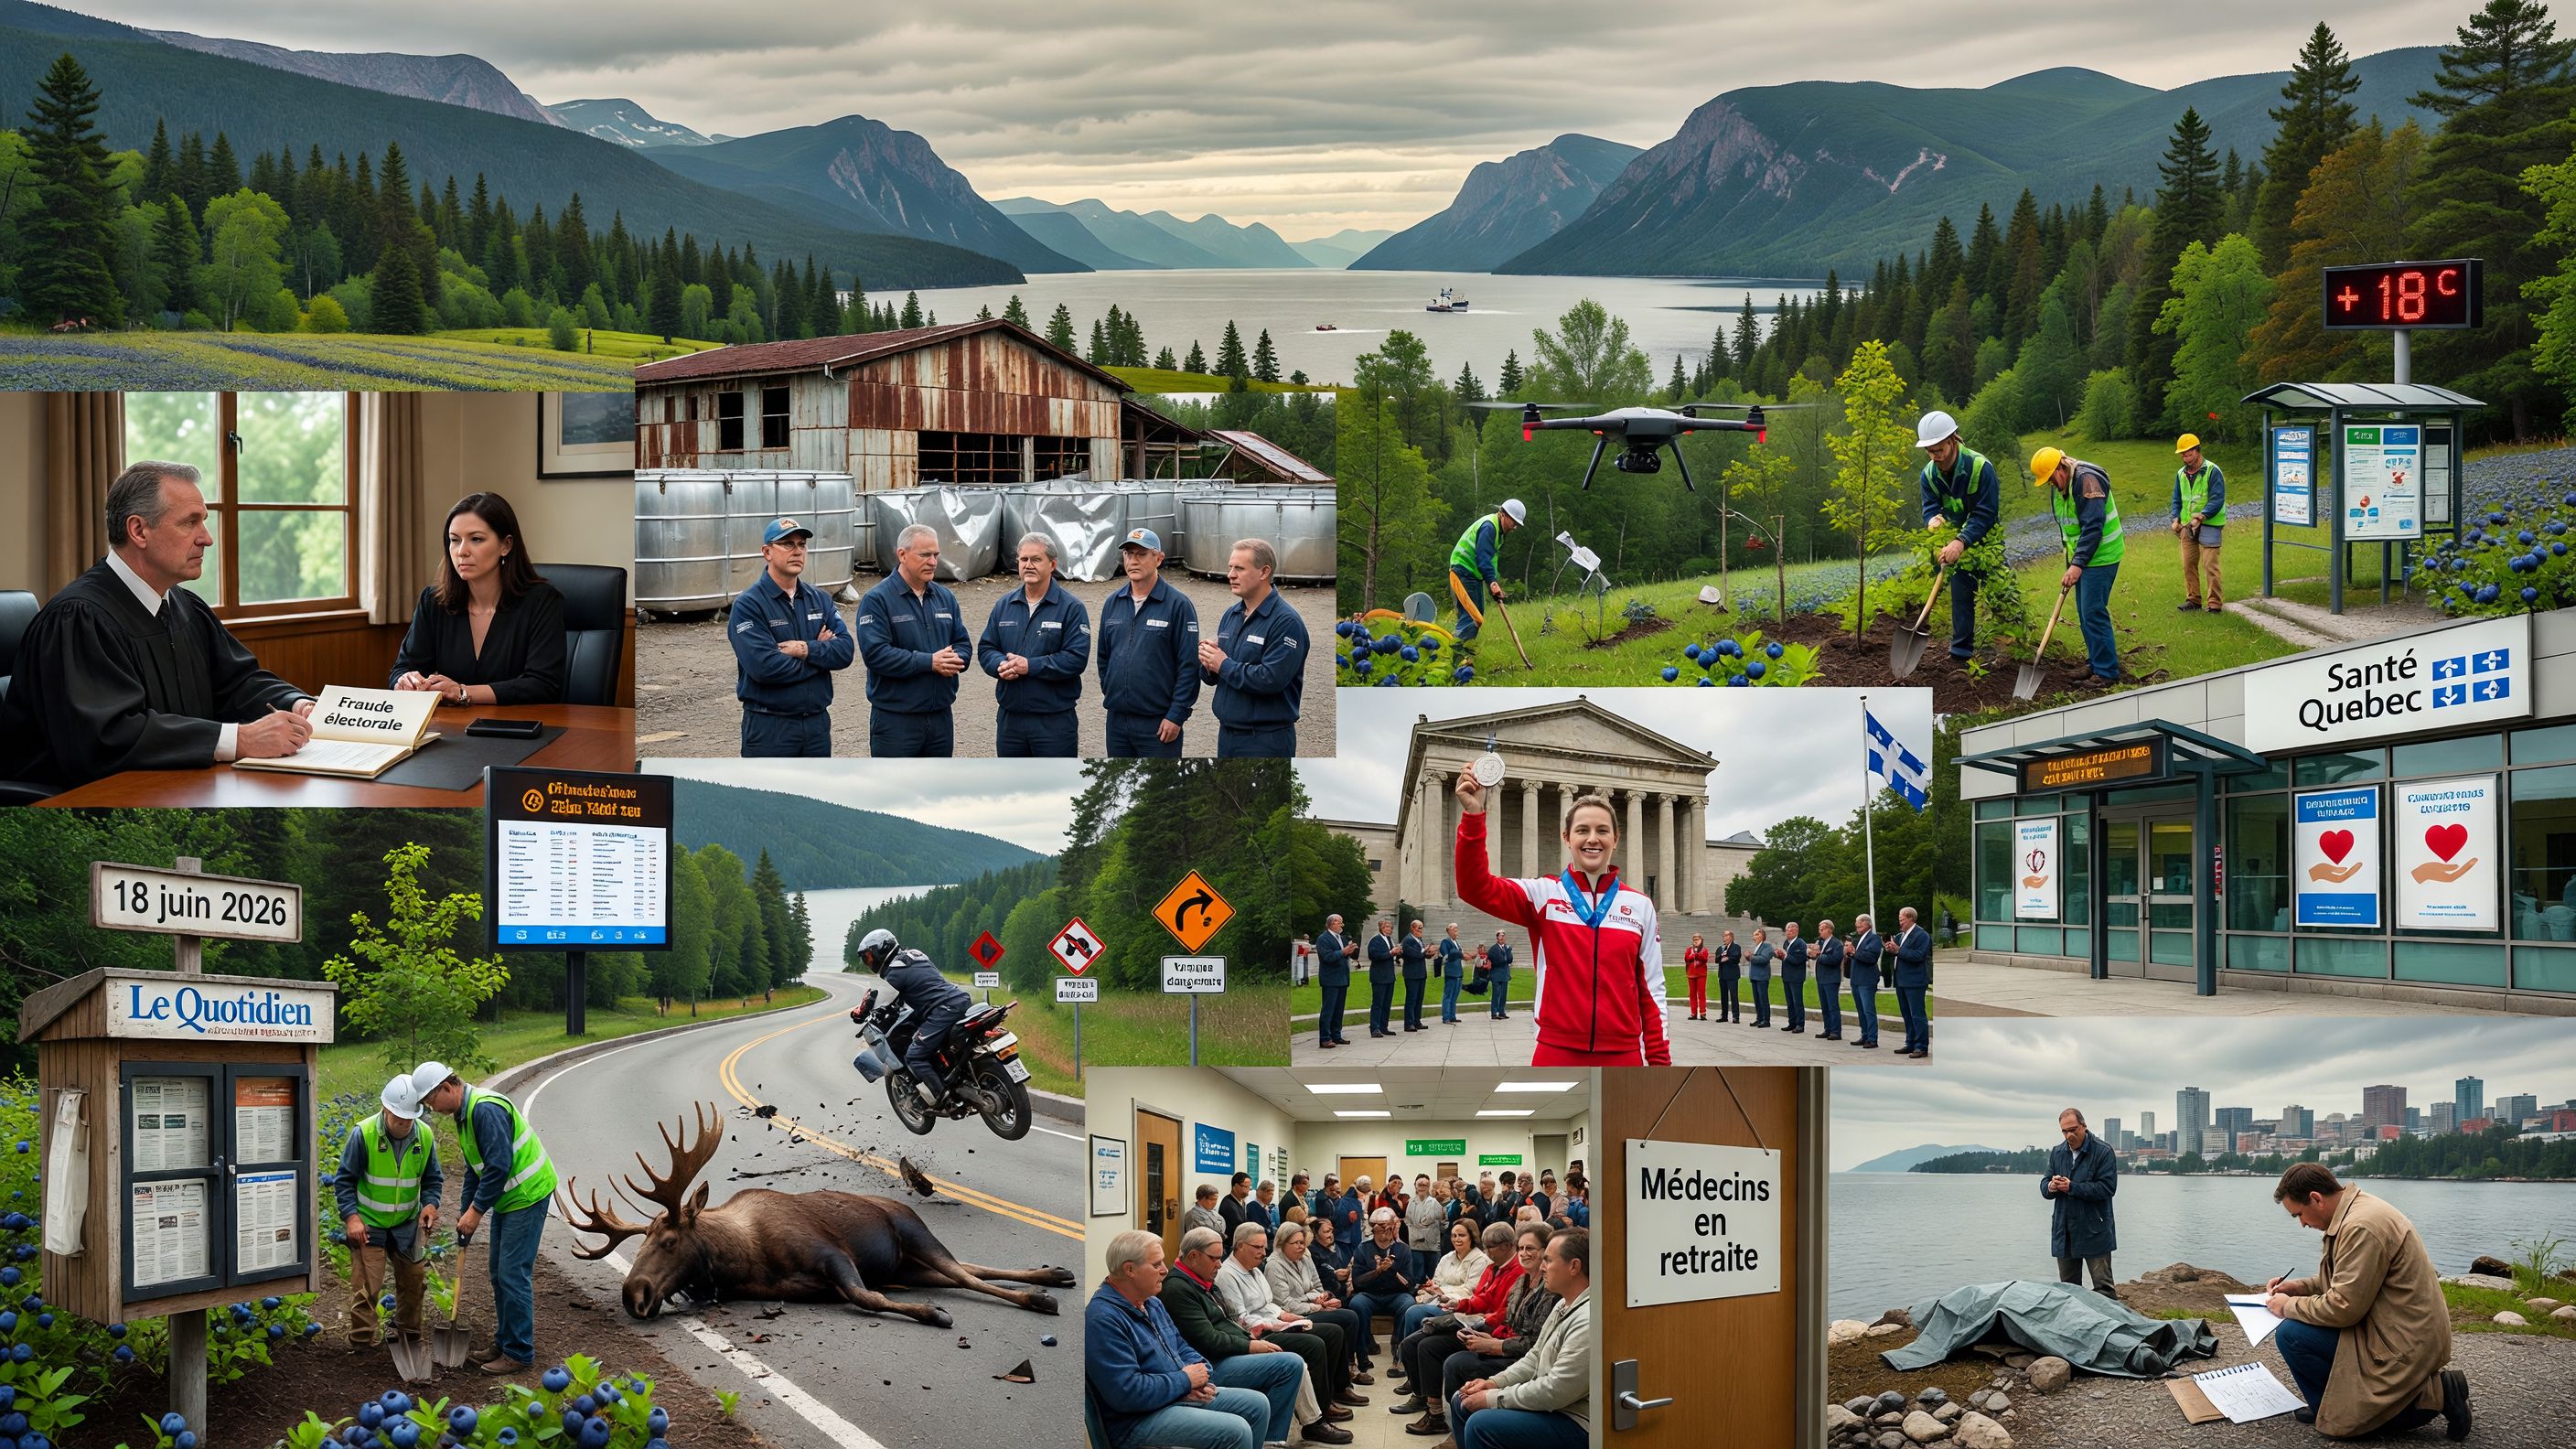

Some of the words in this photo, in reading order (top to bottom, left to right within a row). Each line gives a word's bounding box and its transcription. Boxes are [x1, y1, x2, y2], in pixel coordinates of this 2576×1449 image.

[2327, 648, 2418, 692] Santé
[324, 713, 402, 731] électorale
[338, 696, 394, 714] Fraude
[2298, 688, 2422, 732] Quebec
[113, 879, 149, 914] 18
[158, 884, 211, 924] juin
[220, 892, 287, 927] 2026
[129, 984, 170, 1020] Le
[175, 988, 313, 1034] Quotidien
[1641, 1166, 1770, 1202] Médecins
[1694, 1213, 1726, 1237] en
[1660, 1241, 1758, 1276] retraite
